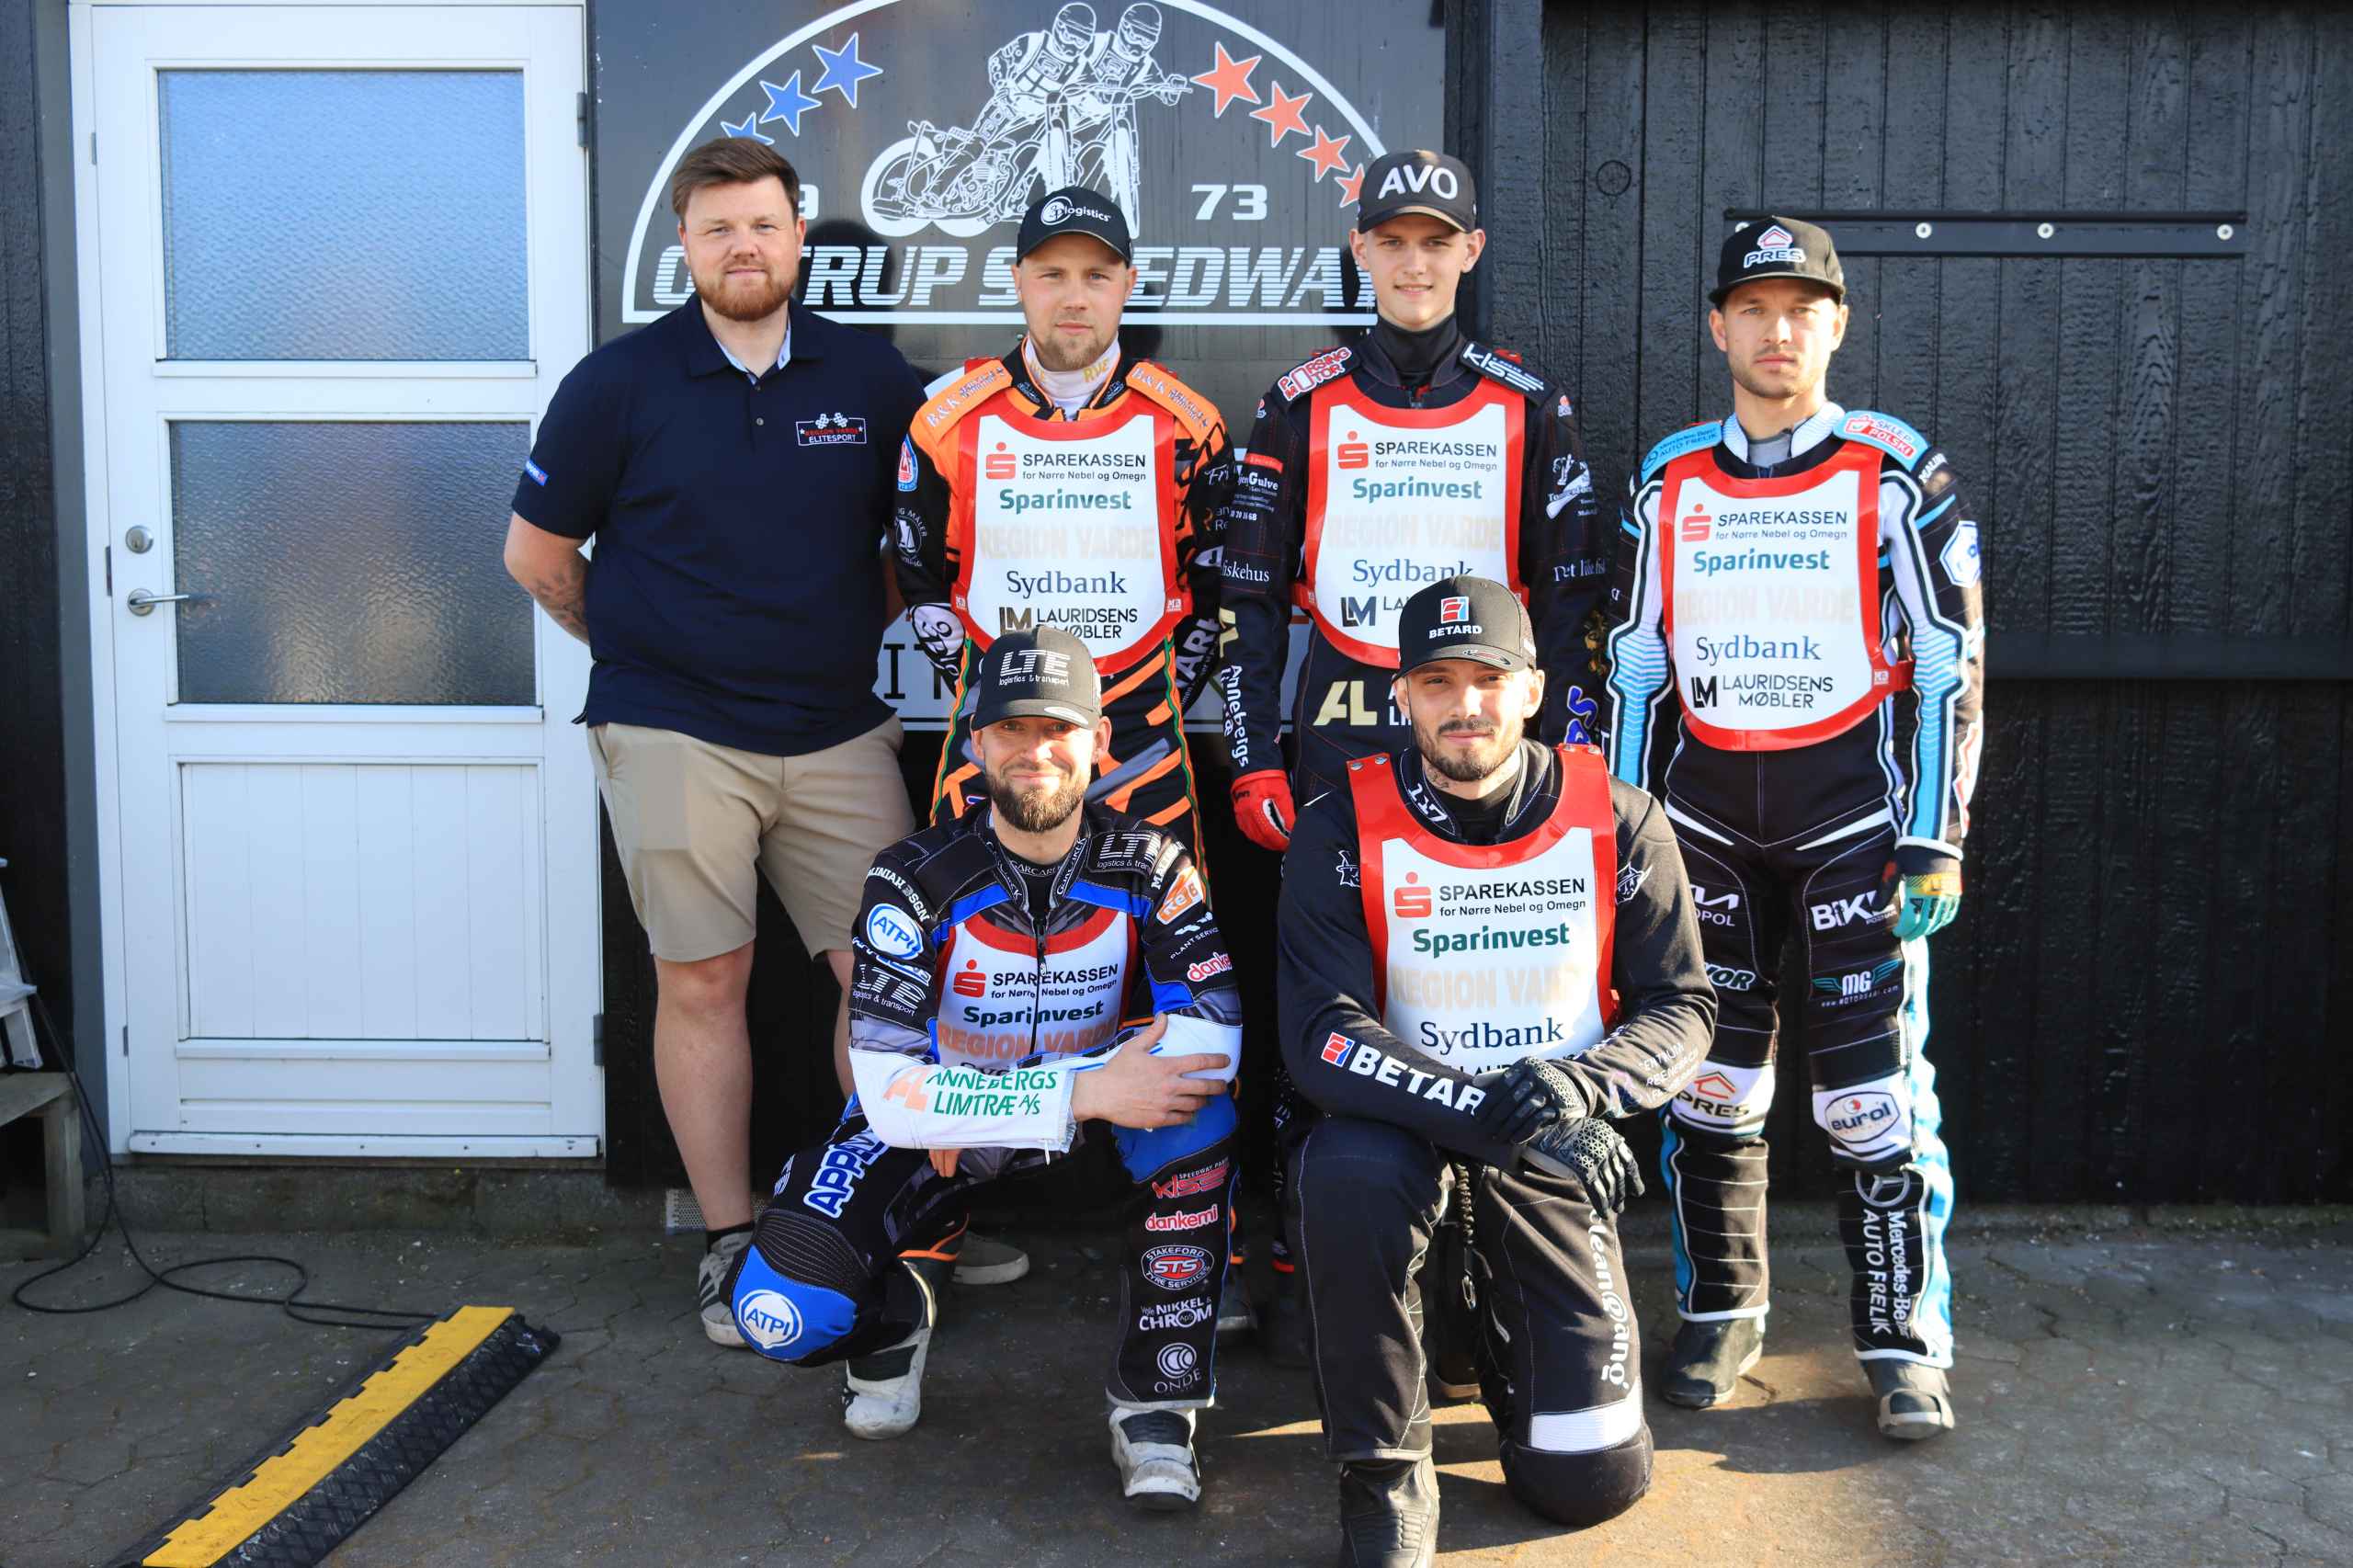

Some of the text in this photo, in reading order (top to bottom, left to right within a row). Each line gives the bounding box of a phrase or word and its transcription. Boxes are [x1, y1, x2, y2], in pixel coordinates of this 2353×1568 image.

[1377, 164, 1460, 200] AVO
[1190, 184, 1268, 221] 73
[1744, 248, 1806, 268] PRES
[809, 434, 857, 443] ELITESPORT
[1866, 427, 1915, 459] POLSKI
[1876, 419, 1913, 442] SKLEP
[1022, 453, 1146, 468] SPAREKASSEN
[1375, 441, 1497, 457] SPAREKASSEN
[1022, 471, 1146, 482] for Nørre Nebel og Omegn
[1375, 459, 1497, 472] for Nørre Nebel og Omegn
[999, 488, 1132, 515] Sparinvest
[1352, 475, 1483, 504] Sparinvest
[1717, 510, 1847, 528] SPAREKASSEN
[1715, 528, 1847, 541] for Nørre Nebel og Omegn
[1352, 558, 1474, 588] Sydbank
[1693, 548, 1830, 577] Sparinvest
[1006, 570, 1128, 599] Sydbank
[1037, 608, 1138, 623] LAURIDSENS
[1428, 624, 1483, 640] BETARD
[1000, 649, 1072, 676] LTE
[1696, 634, 1822, 666] Sydbank
[1722, 674, 1833, 693] LAURIDSENS
[1313, 680, 1379, 726] AL
[1738, 693, 1815, 710] MØBLER
[1230, 664, 1250, 768] Annebergs
[1438, 878, 1586, 902] SPAREKASSEN
[1439, 900, 1586, 917] for Nørre Nebel og Omegn
[1169, 937, 1196, 960] PLANT
[1413, 922, 1571, 959] Sparinvest
[992, 963, 1119, 987] SPAREKASSEN
[1842, 971, 1872, 996] MG
[991, 979, 1118, 999] for Nørre Nebel og Omegn
[881, 997, 916, 1017] transport
[962, 1000, 1104, 1028] Sparinvest
[938, 1021, 1031, 1059] REGION
[1419, 1017, 1565, 1056] Sydbank
[1347, 1043, 1487, 1117] BETAR
[933, 1091, 1017, 1116] LIMTRÆ
[1676, 1090, 1750, 1119] PRES
[1831, 1101, 1892, 1131] eurol
[1178, 1164, 1213, 1179] SPEEDWAY
[1144, 1202, 1219, 1232] dankemi
[1145, 1246, 1206, 1262] STAKEFORD
[1153, 1258, 1199, 1275] STS
[1145, 1270, 1166, 1288] TYRE
[1862, 1209, 1893, 1335] AUTO FRELIK
[1138, 1303, 1213, 1332] CHROM
[1155, 1297, 1206, 1316] NIKKEL
[745, 1307, 791, 1336] ATPI
[1154, 1368, 1203, 1394] ONDE
